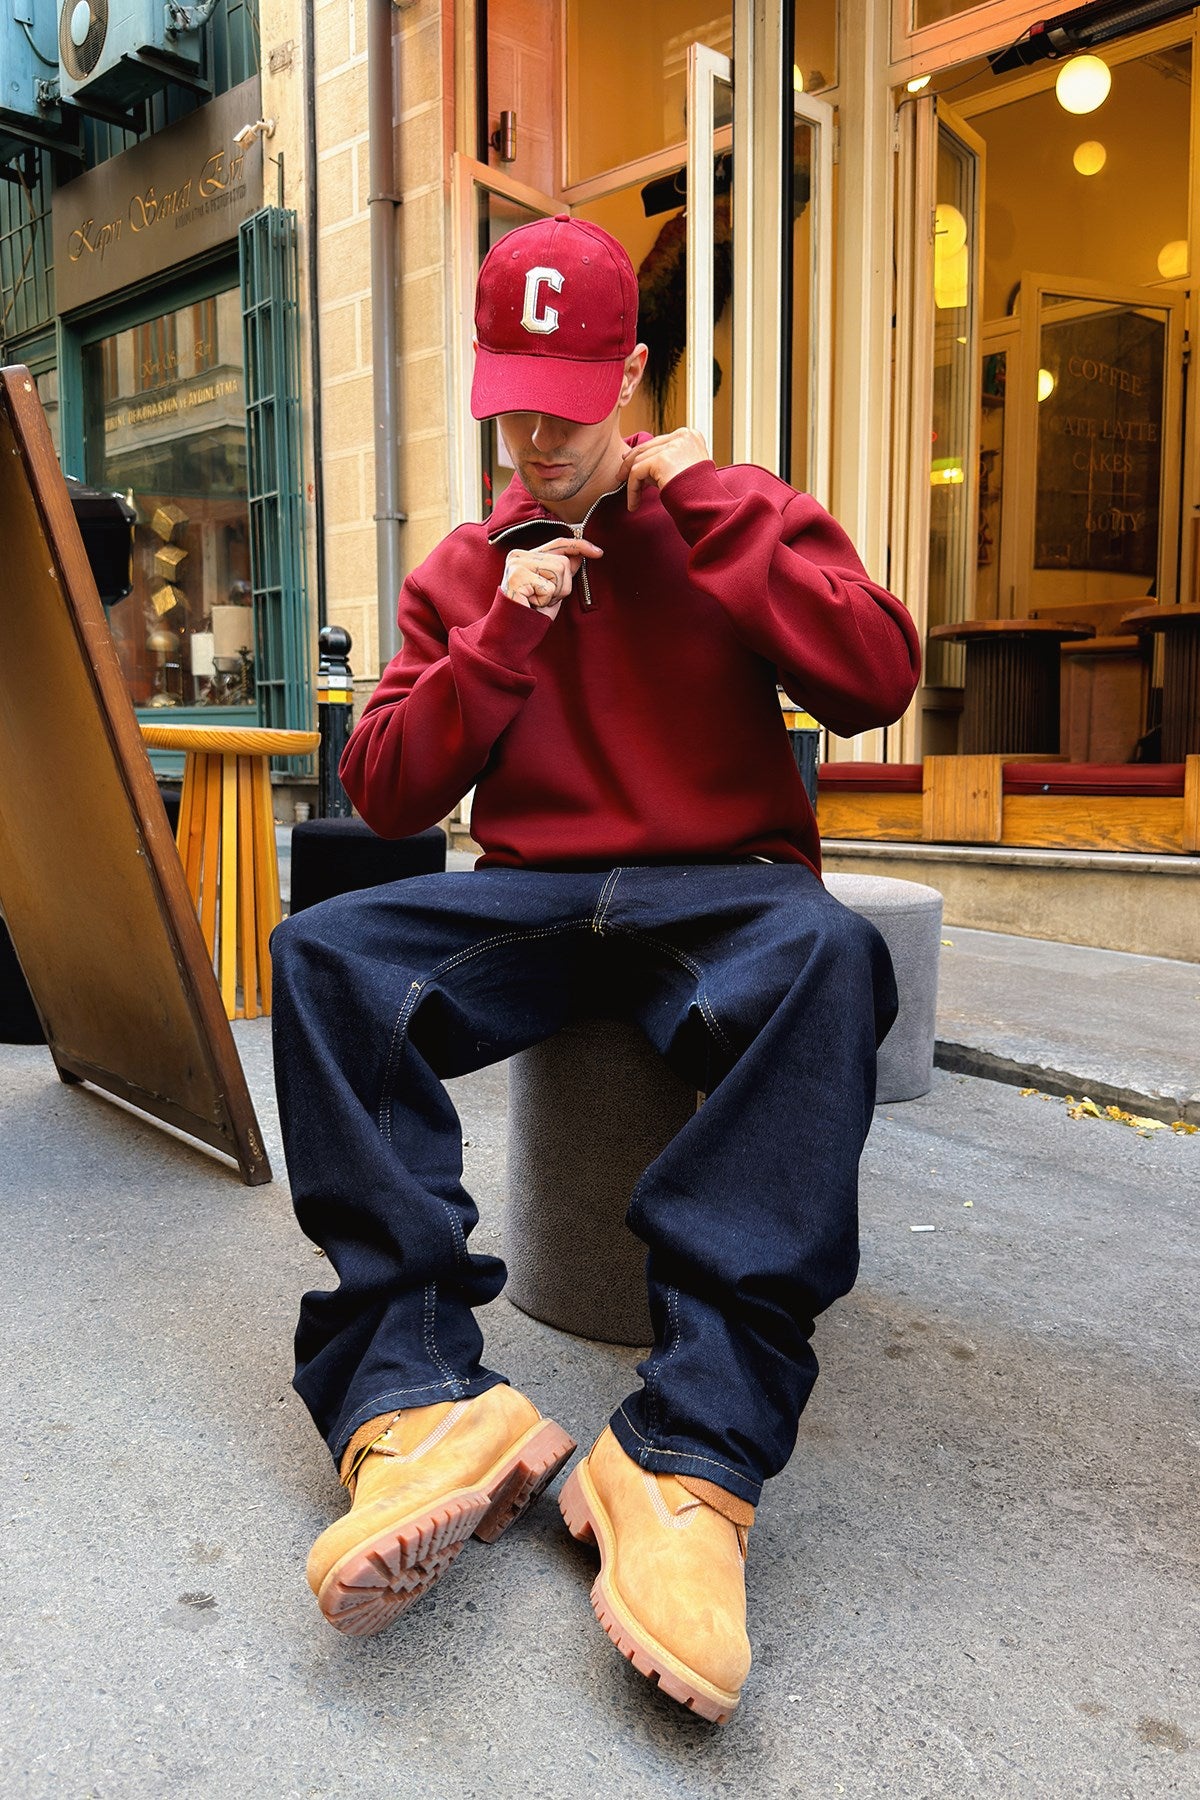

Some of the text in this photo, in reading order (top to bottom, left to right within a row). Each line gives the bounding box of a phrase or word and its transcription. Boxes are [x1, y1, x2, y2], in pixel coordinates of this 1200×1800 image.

[129, 178, 192, 232] Sanat
[199, 150, 245, 198] Evi
[520, 266, 565, 334] C
[188, 379, 238, 406] AYDINLATMA
[1068, 355, 1142, 397] COFFEE
[1103, 418, 1158, 442] LATTE
[1073, 450, 1133, 473] CAKES
